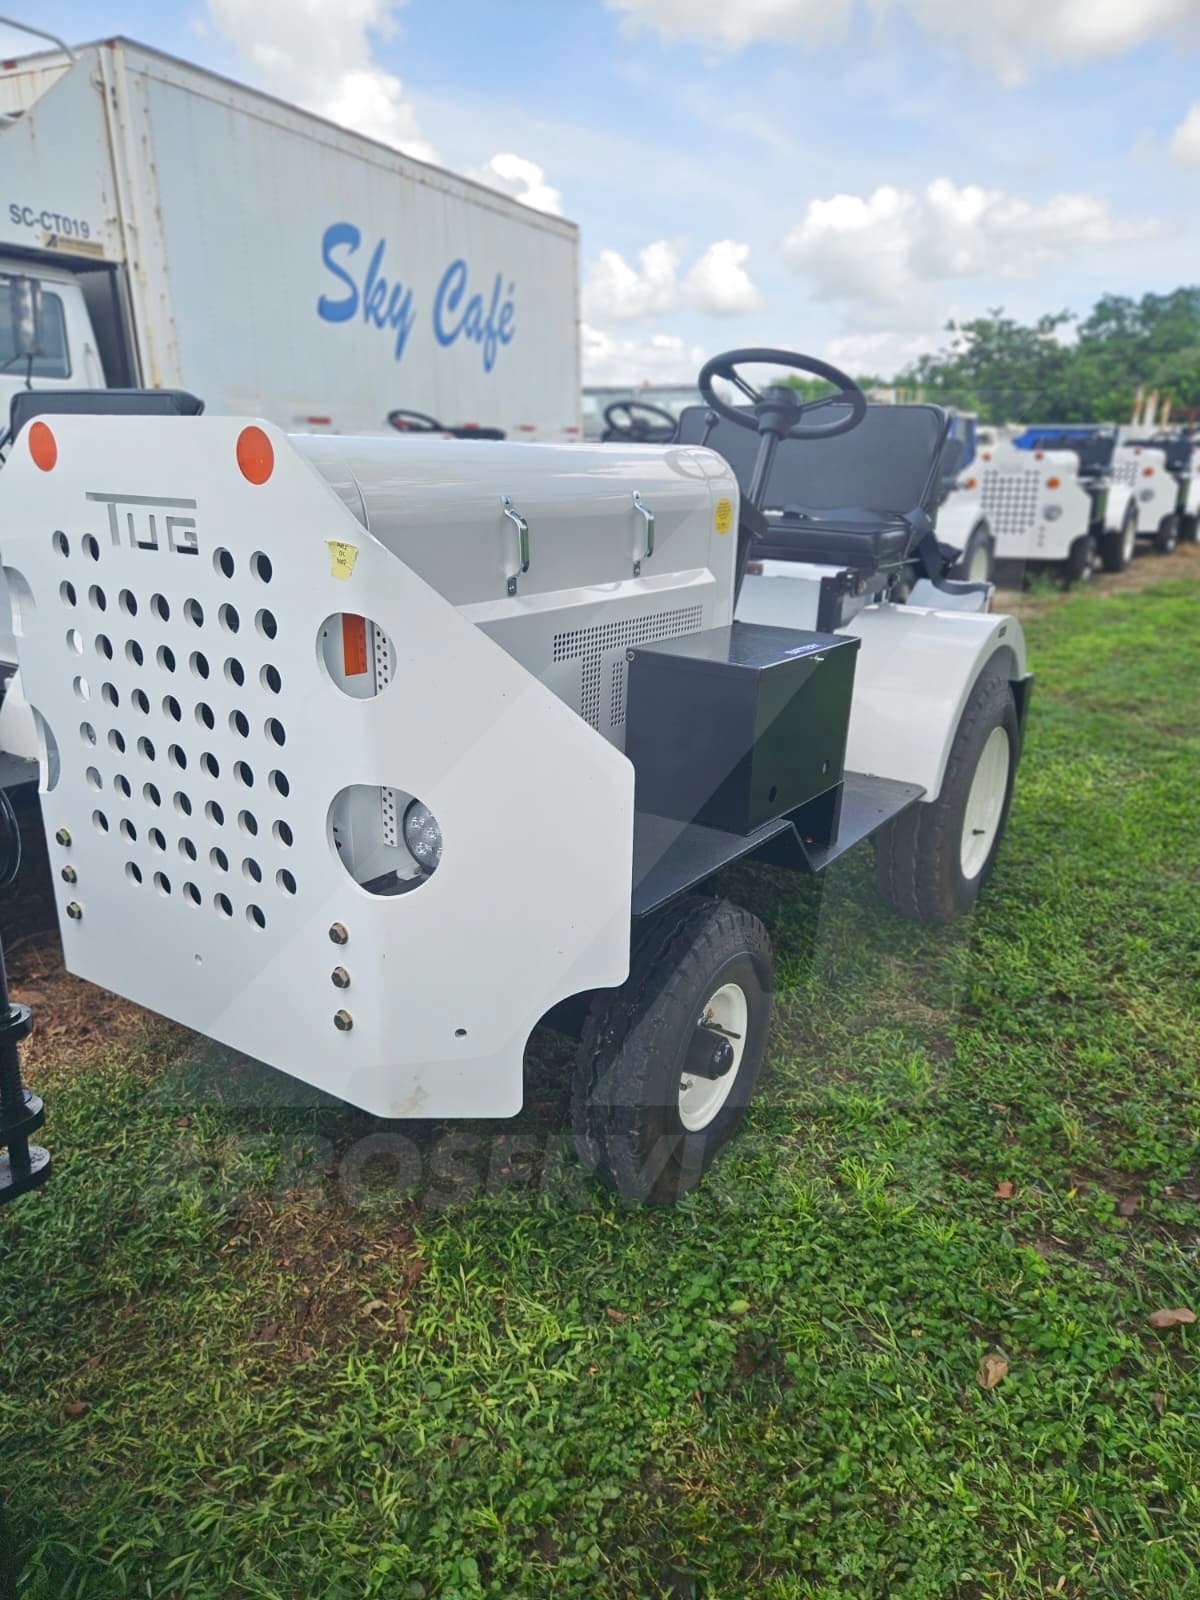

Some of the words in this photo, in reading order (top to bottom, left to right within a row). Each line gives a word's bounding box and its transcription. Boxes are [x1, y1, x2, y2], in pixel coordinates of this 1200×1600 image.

[9, 203, 90, 239] SC-CT019
[317, 222, 416, 362] Sky
[432, 258, 516, 373] Café
[85, 491, 199, 555] TUG
